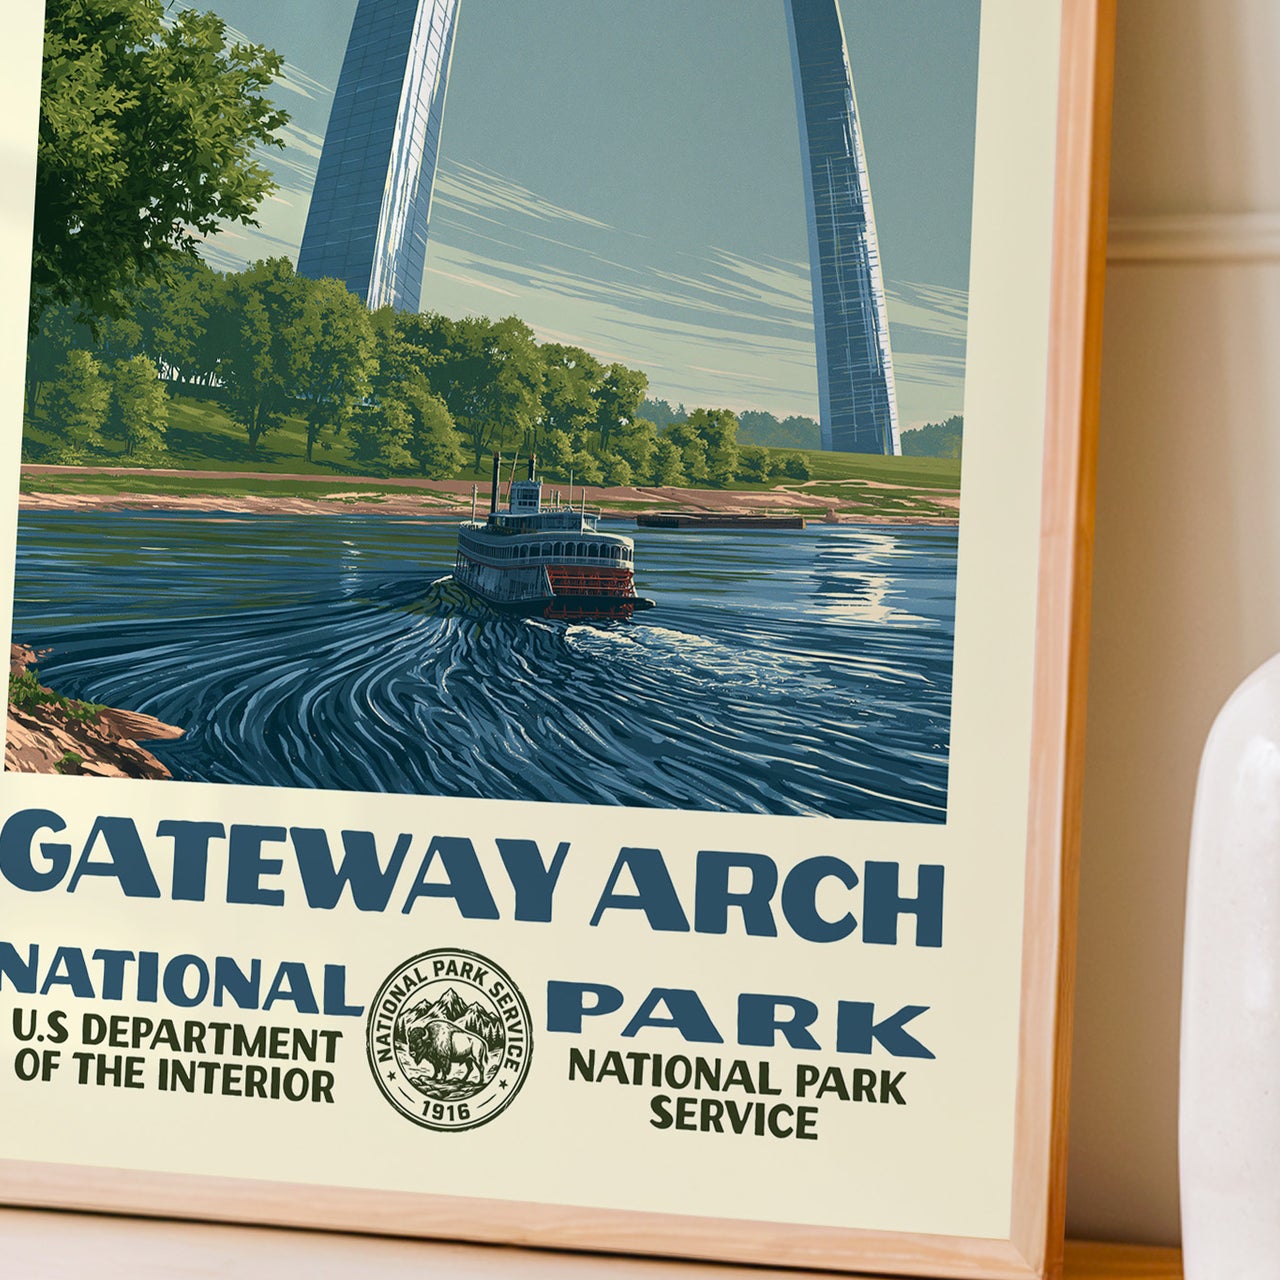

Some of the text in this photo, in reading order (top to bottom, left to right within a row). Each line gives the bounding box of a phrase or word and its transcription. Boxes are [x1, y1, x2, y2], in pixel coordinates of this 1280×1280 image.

[590, 847, 944, 948] ARCH
[13, 1008, 343, 1063] U.S DEPARTMENT
[376, 960, 523, 1072] NATIONAL PARK SERVICE
[547, 981, 936, 1059] PARK
[15, 1048, 334, 1103] OF THE INTERIOR
[569, 1048, 906, 1105] NATIONAL PARK
[422, 1100, 470, 1121] 1916
[650, 1095, 818, 1140] SERVICE
